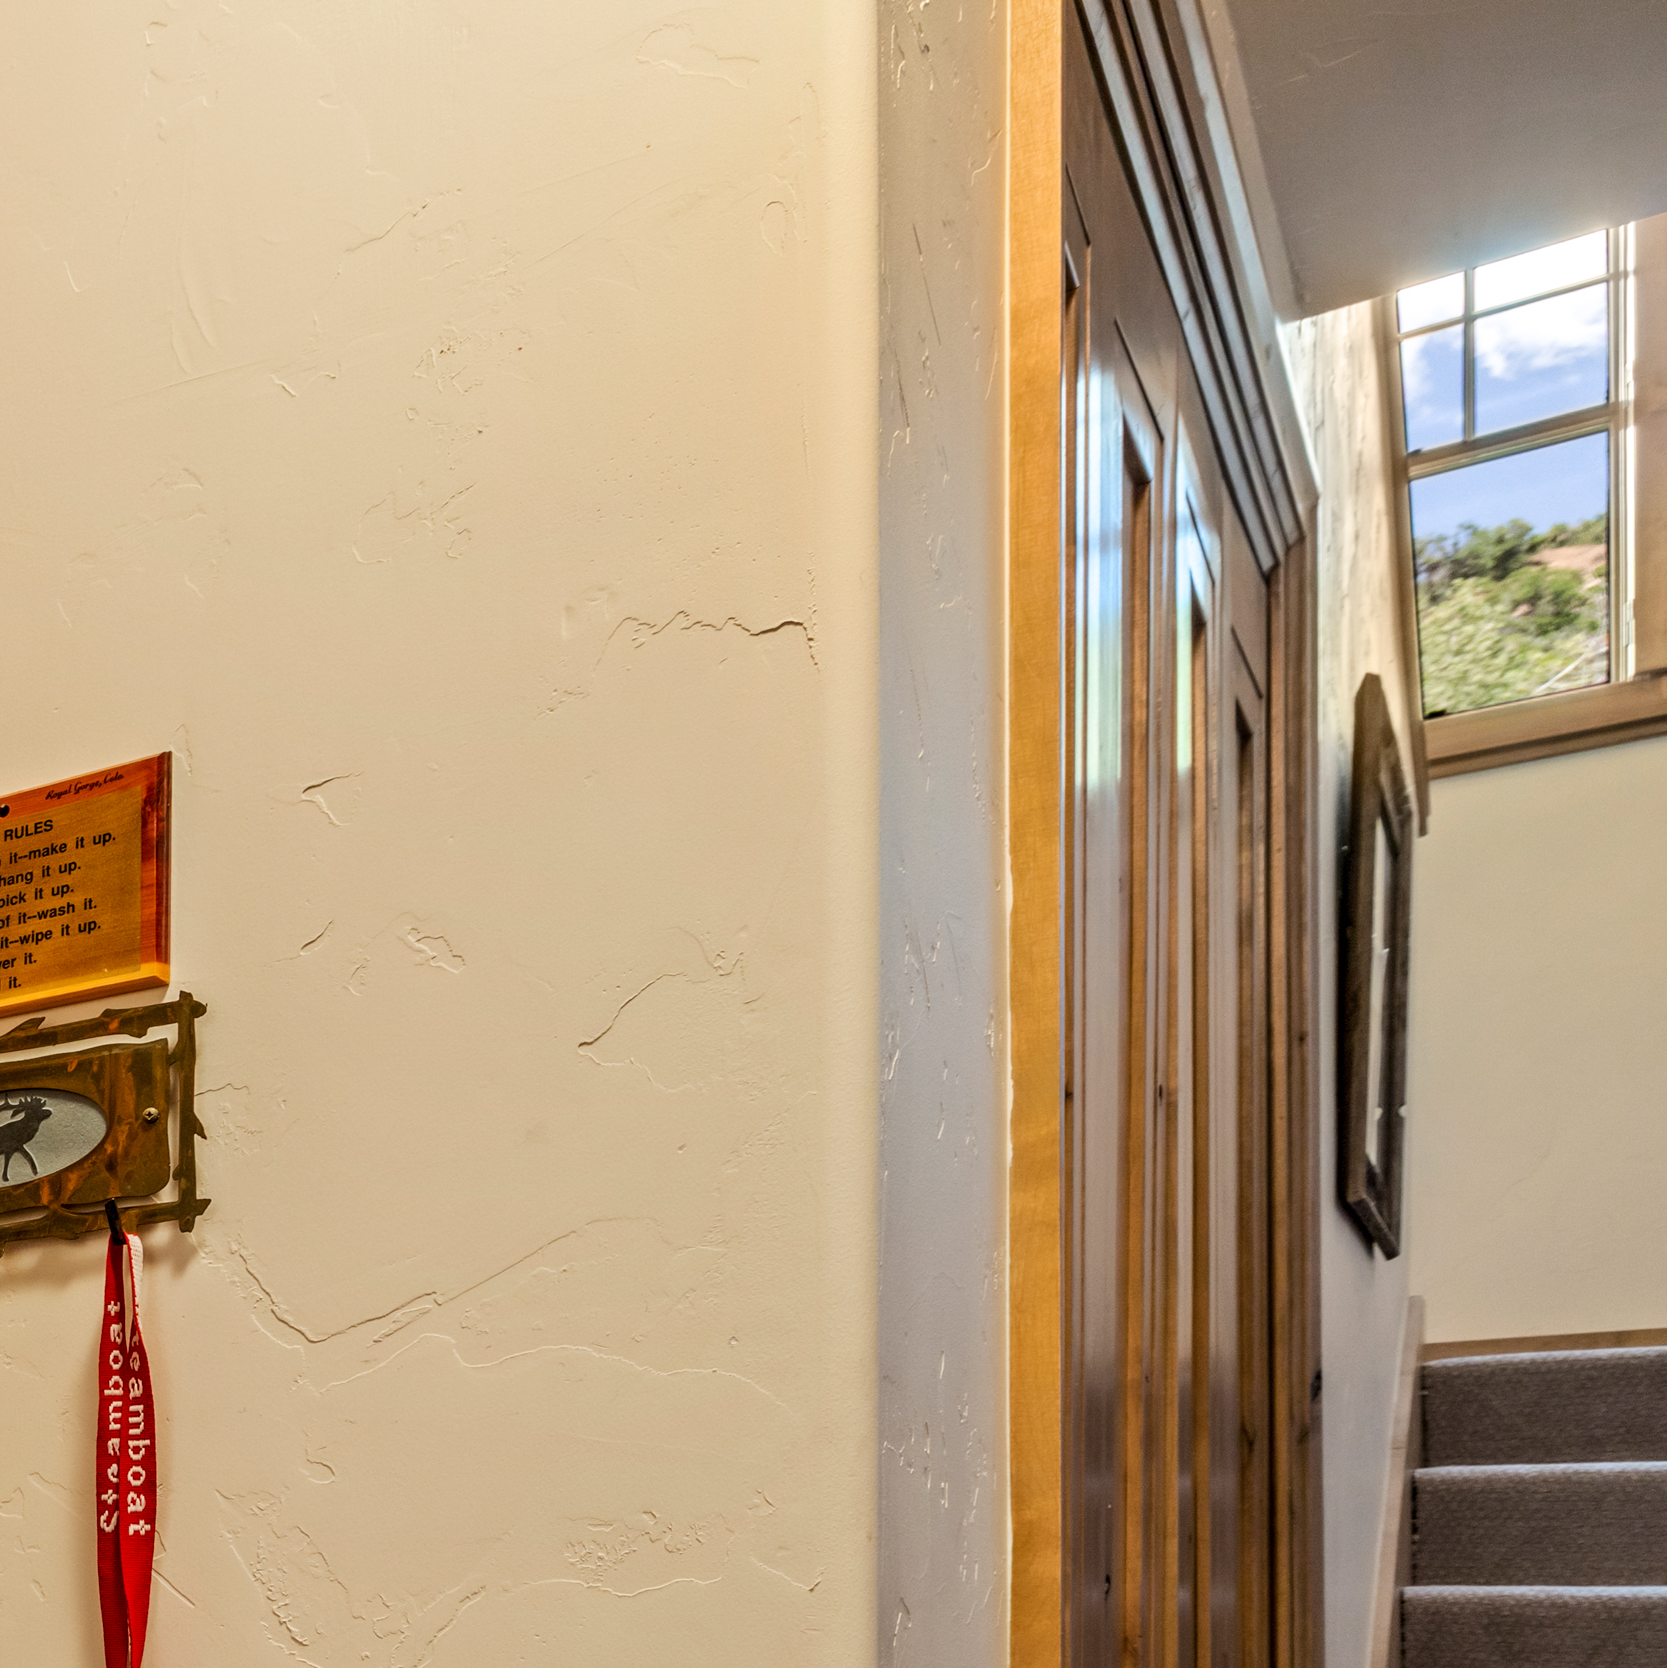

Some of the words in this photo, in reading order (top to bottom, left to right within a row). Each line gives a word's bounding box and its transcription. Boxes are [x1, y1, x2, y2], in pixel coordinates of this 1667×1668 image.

[45, 784, 72, 800] Royal
[3, 819, 54, 842] RULES
[75, 836, 85, 850] it
[92, 832, 116, 847] up.
[41, 865, 51, 879] it
[58, 861, 82, 876] up.
[34, 887, 44, 901] it
[51, 883, 74, 899] up.
[83, 897, 97, 911] it.
[60, 923, 71, 937] it
[77, 920, 101, 935] up.
[23, 952, 37, 966] it.
[8, 976, 22, 990] it.
[99, 1300, 125, 1534] Steamboat
[127, 1329, 152, 1537] teamboat
